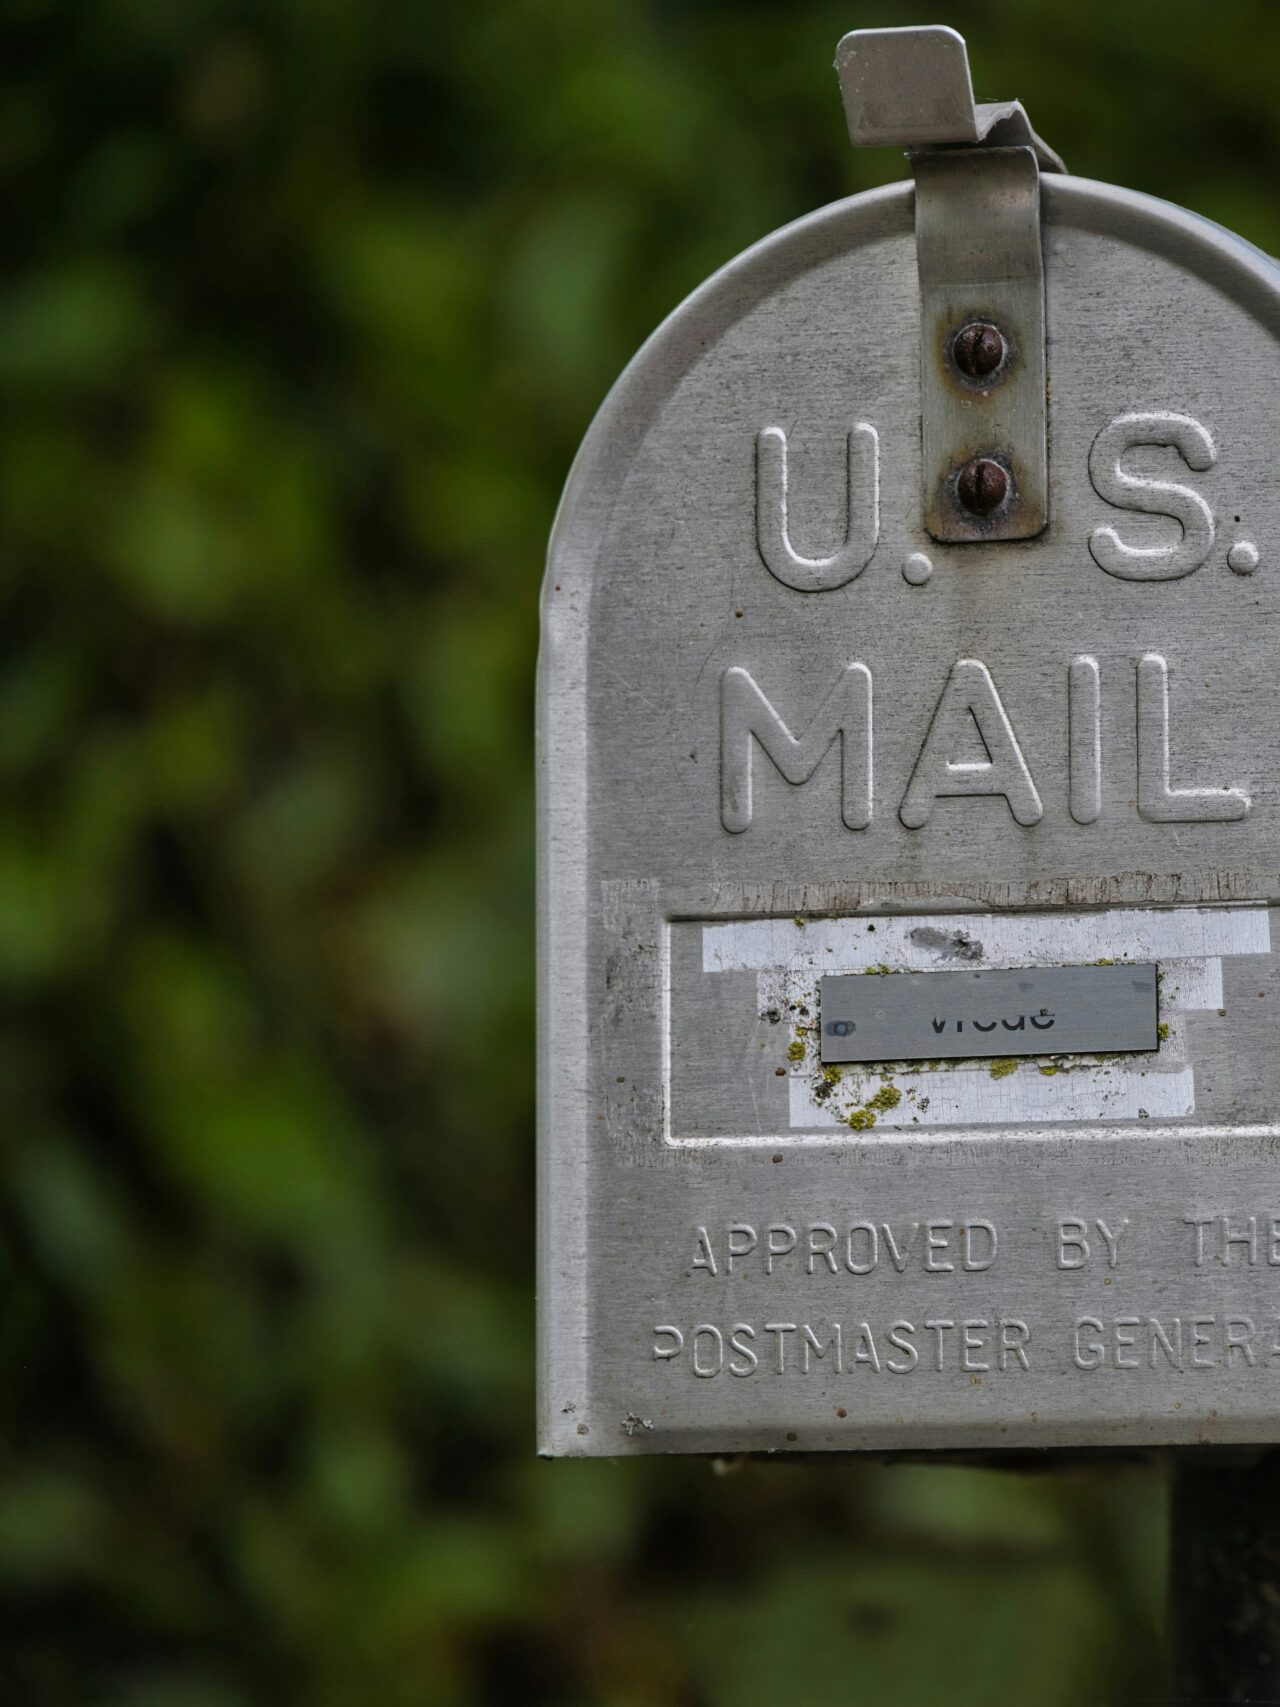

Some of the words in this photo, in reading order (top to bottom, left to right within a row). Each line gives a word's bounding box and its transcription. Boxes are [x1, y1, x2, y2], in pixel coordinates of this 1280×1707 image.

[718, 651, 1253, 834] MAIL
[685, 1219, 998, 1277] APPROVED
[1056, 1217, 1130, 1271] BY
[652, 1318, 1030, 1379] POSTMASTER
